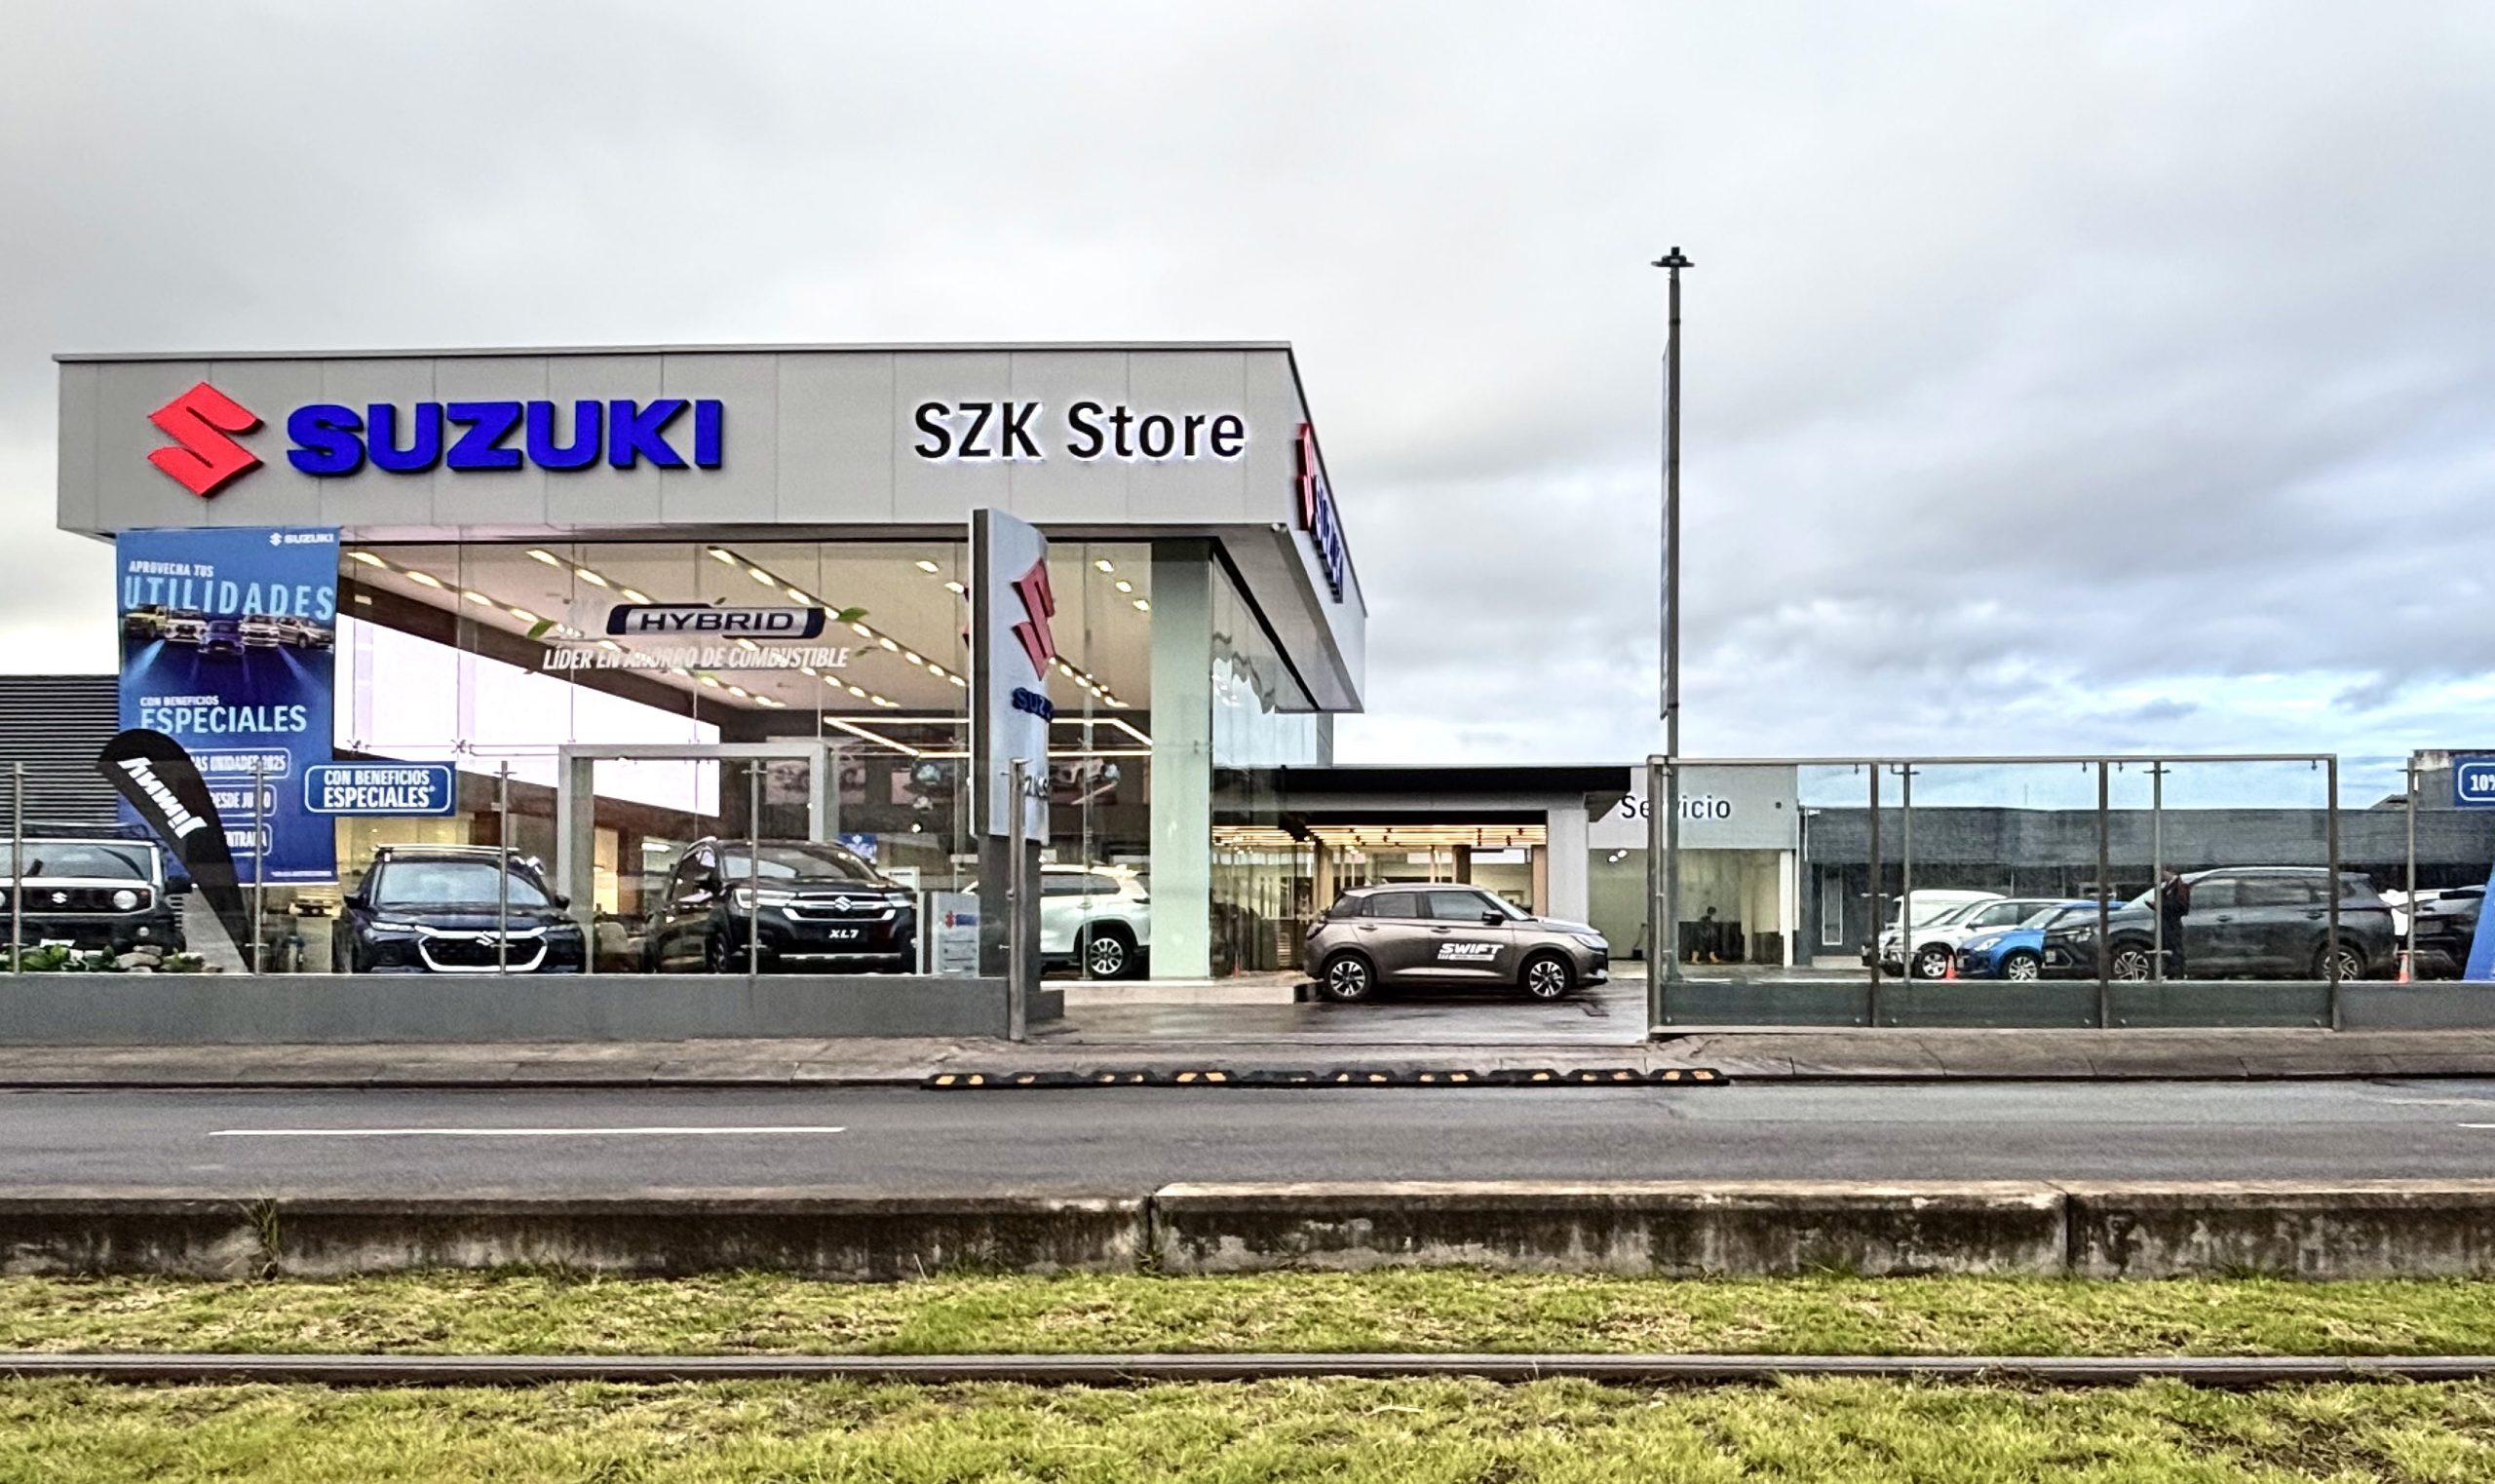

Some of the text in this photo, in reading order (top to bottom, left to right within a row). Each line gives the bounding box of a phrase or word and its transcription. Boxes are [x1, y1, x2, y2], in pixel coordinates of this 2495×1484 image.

[287, 400, 723, 476] SUZUKI
[914, 400, 1246, 459] SZK Store
[284, 533, 334, 545] SUZUKI
[129, 560, 214, 578] APROVECHA TUS
[124, 575, 334, 621] UTILIDADES
[639, 612, 794, 631] HYBRID
[543, 646, 594, 670] LÍDER
[596, 649, 622, 669] EN
[700, 647, 725, 669] DE
[728, 646, 850, 669] COMBUSTIBLE
[140, 695, 220, 707] CON BENEFICIOS
[1012, 686, 1053, 721] SUZ
[140, 704, 308, 735] ESPECIALES
[324, 769, 430, 785] CON BENEFICIOS
[117, 757, 208, 839] Jimny
[1621, 794, 1731, 819] Seicio
[829, 930, 859, 938] XL7
[1439, 942, 1504, 955] SWIFT
